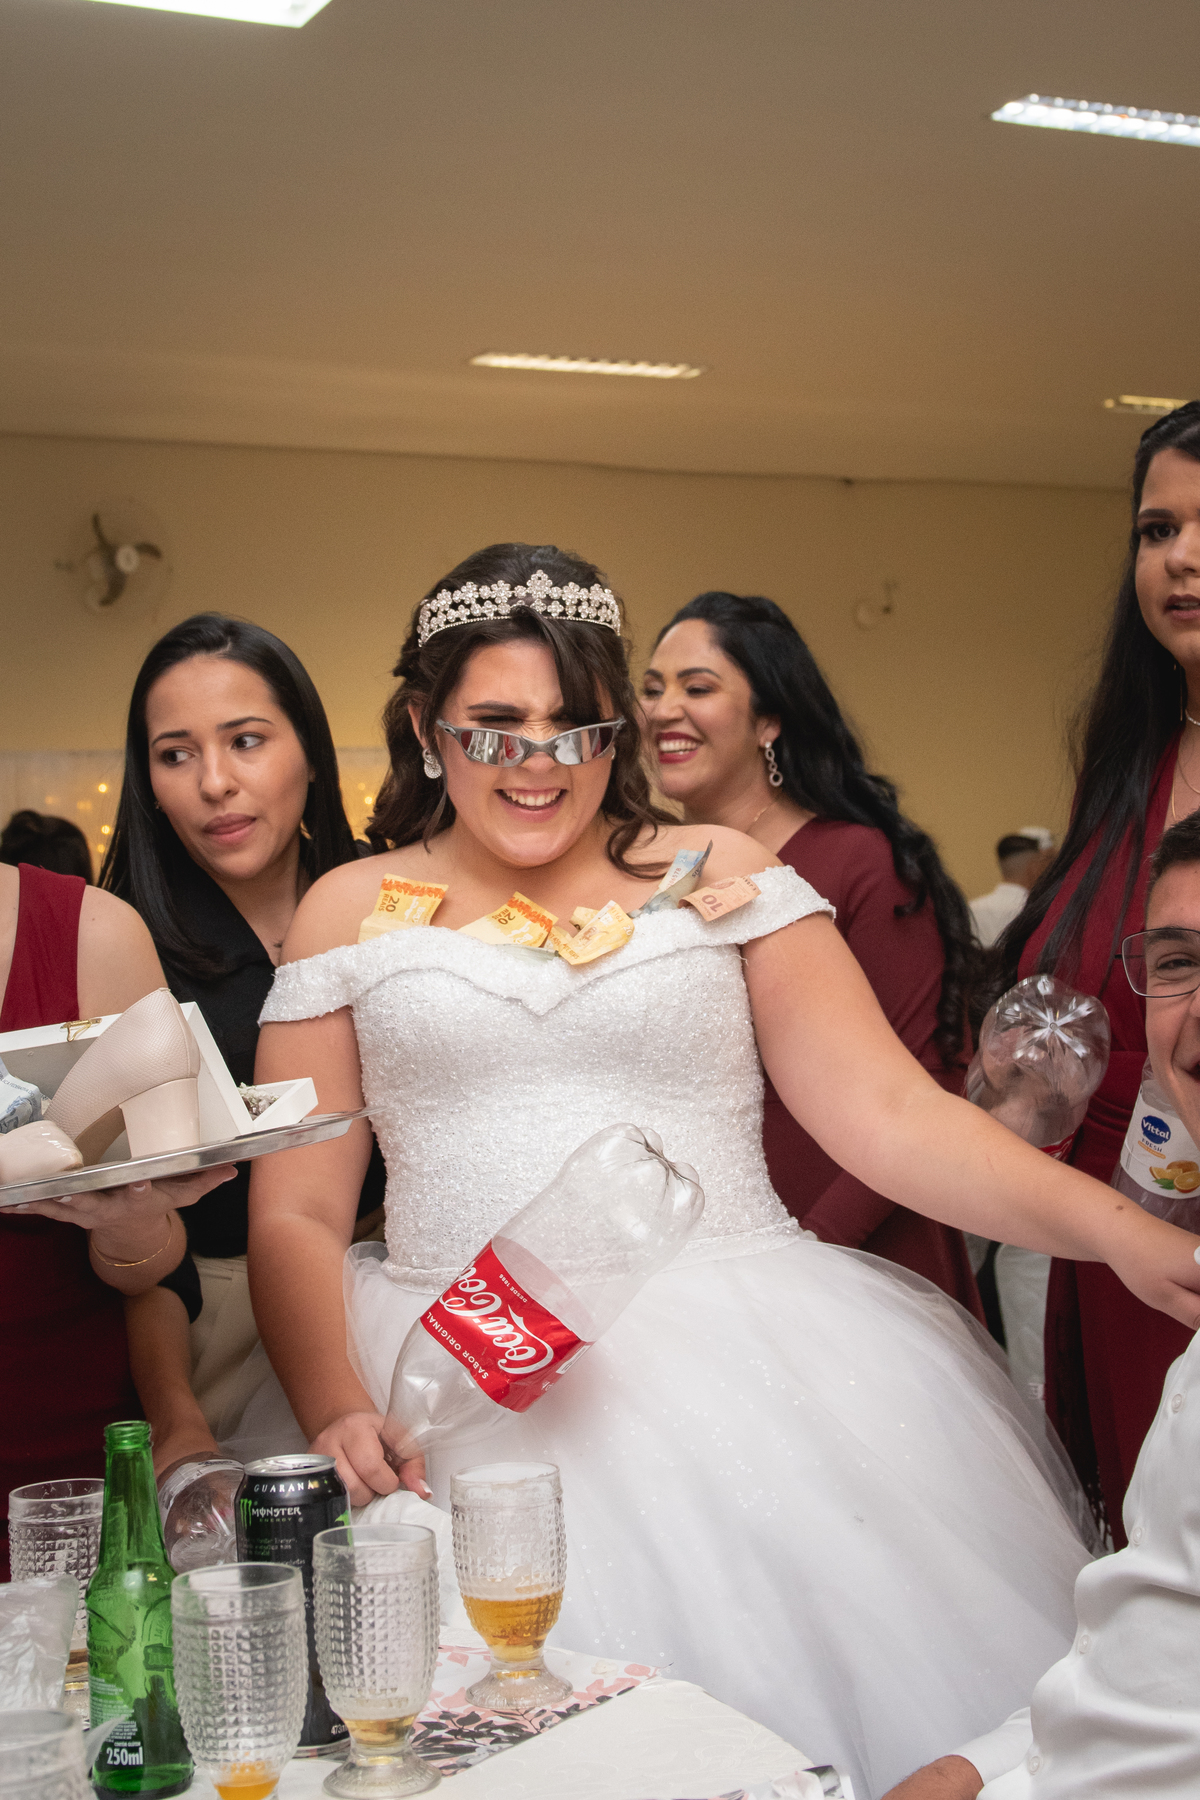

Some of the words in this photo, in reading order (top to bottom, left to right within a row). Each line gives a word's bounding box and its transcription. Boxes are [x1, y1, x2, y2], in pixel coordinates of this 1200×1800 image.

[385, 896, 400, 912] 20
[701, 894, 724, 913] 10
[497, 912, 516, 925] 20
[1142, 1118, 1170, 1140] Vittal
[1141, 1137, 1163, 1153] FRESH
[426, 1311, 462, 1352] ORIGINAL
[462, 1350, 489, 1380] SABOR
[106, 1746, 144, 1767] 250ml
